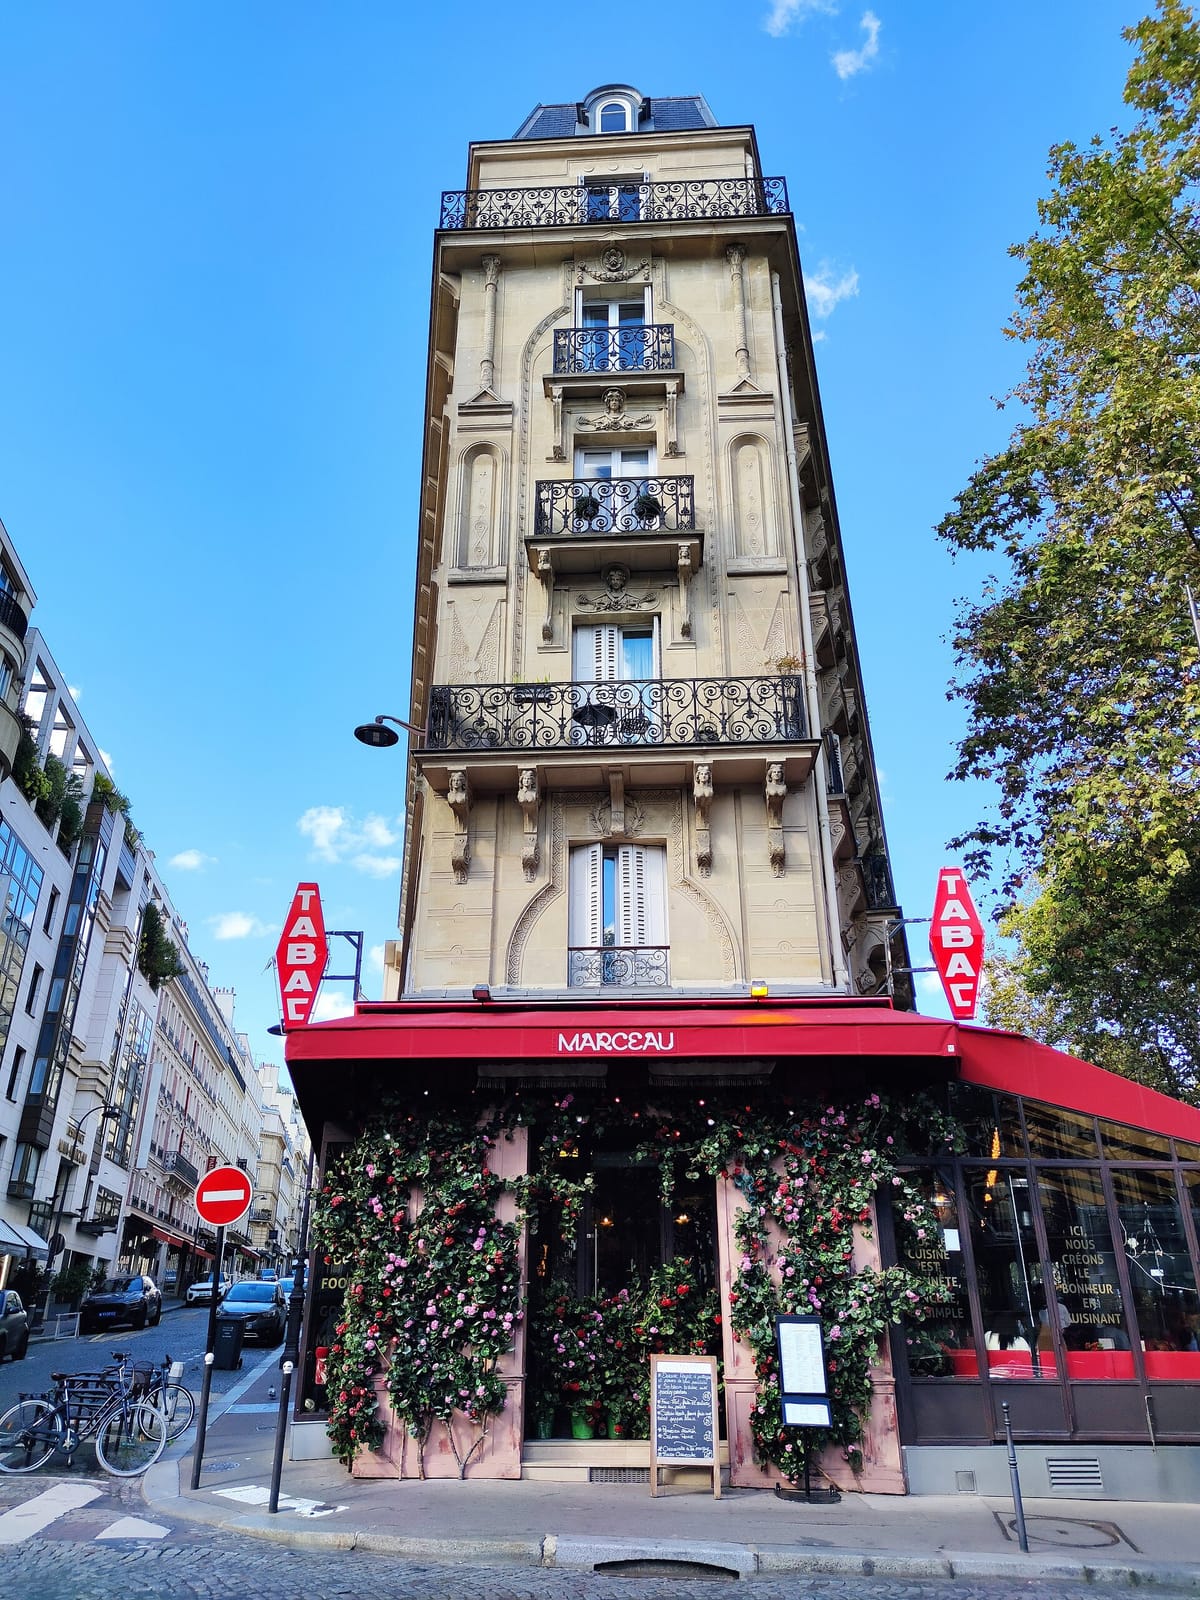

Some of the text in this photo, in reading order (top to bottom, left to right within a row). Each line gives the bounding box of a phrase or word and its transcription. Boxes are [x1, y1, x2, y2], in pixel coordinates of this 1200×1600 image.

[940, 875, 976, 1007] TABAC
[284, 890, 317, 1021] TABAC
[558, 1032, 674, 1051] MARCEAU
[1065, 1239, 1096, 1250] NOUS
[908, 1248, 951, 1260] CUISINE
[1062, 1252, 1105, 1265] CRÉONS
[1078, 1268, 1091, 1279] LE
[321, 1277, 348, 1290] FOO
[1062, 1283, 1114, 1294] BONHEUR
[925, 1306, 965, 1319] SIMPLE
[1071, 1313, 1121, 1324] UISINANT
